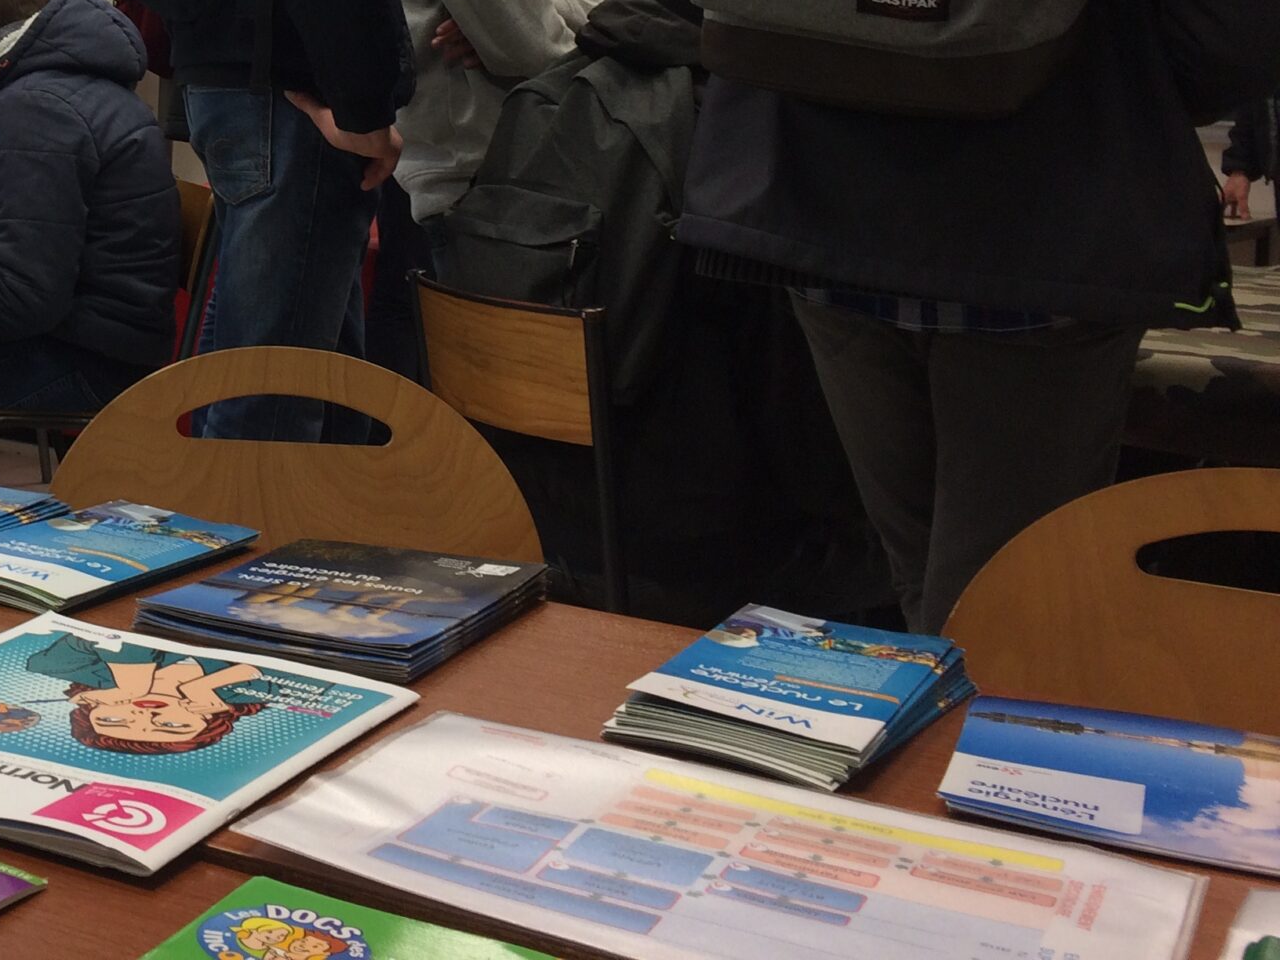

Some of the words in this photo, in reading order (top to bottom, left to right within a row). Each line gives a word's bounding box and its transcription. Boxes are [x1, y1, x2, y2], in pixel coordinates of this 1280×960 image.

[84, 560, 112, 573] Le
[250, 566, 329, 584] énergies
[359, 574, 382, 582] du
[287, 580, 310, 589] La
[335, 577, 362, 587] les
[369, 580, 423, 594] toutes
[690, 668, 822, 702] nucléaire
[279, 687, 334, 706] place
[327, 689, 363, 700] des
[334, 698, 354, 708] la
[828, 699, 863, 711] Le
[971, 780, 1100, 812] nucléaire
[968, 787, 1095, 821] L'énergie
[266, 904, 362, 939] DOCS
